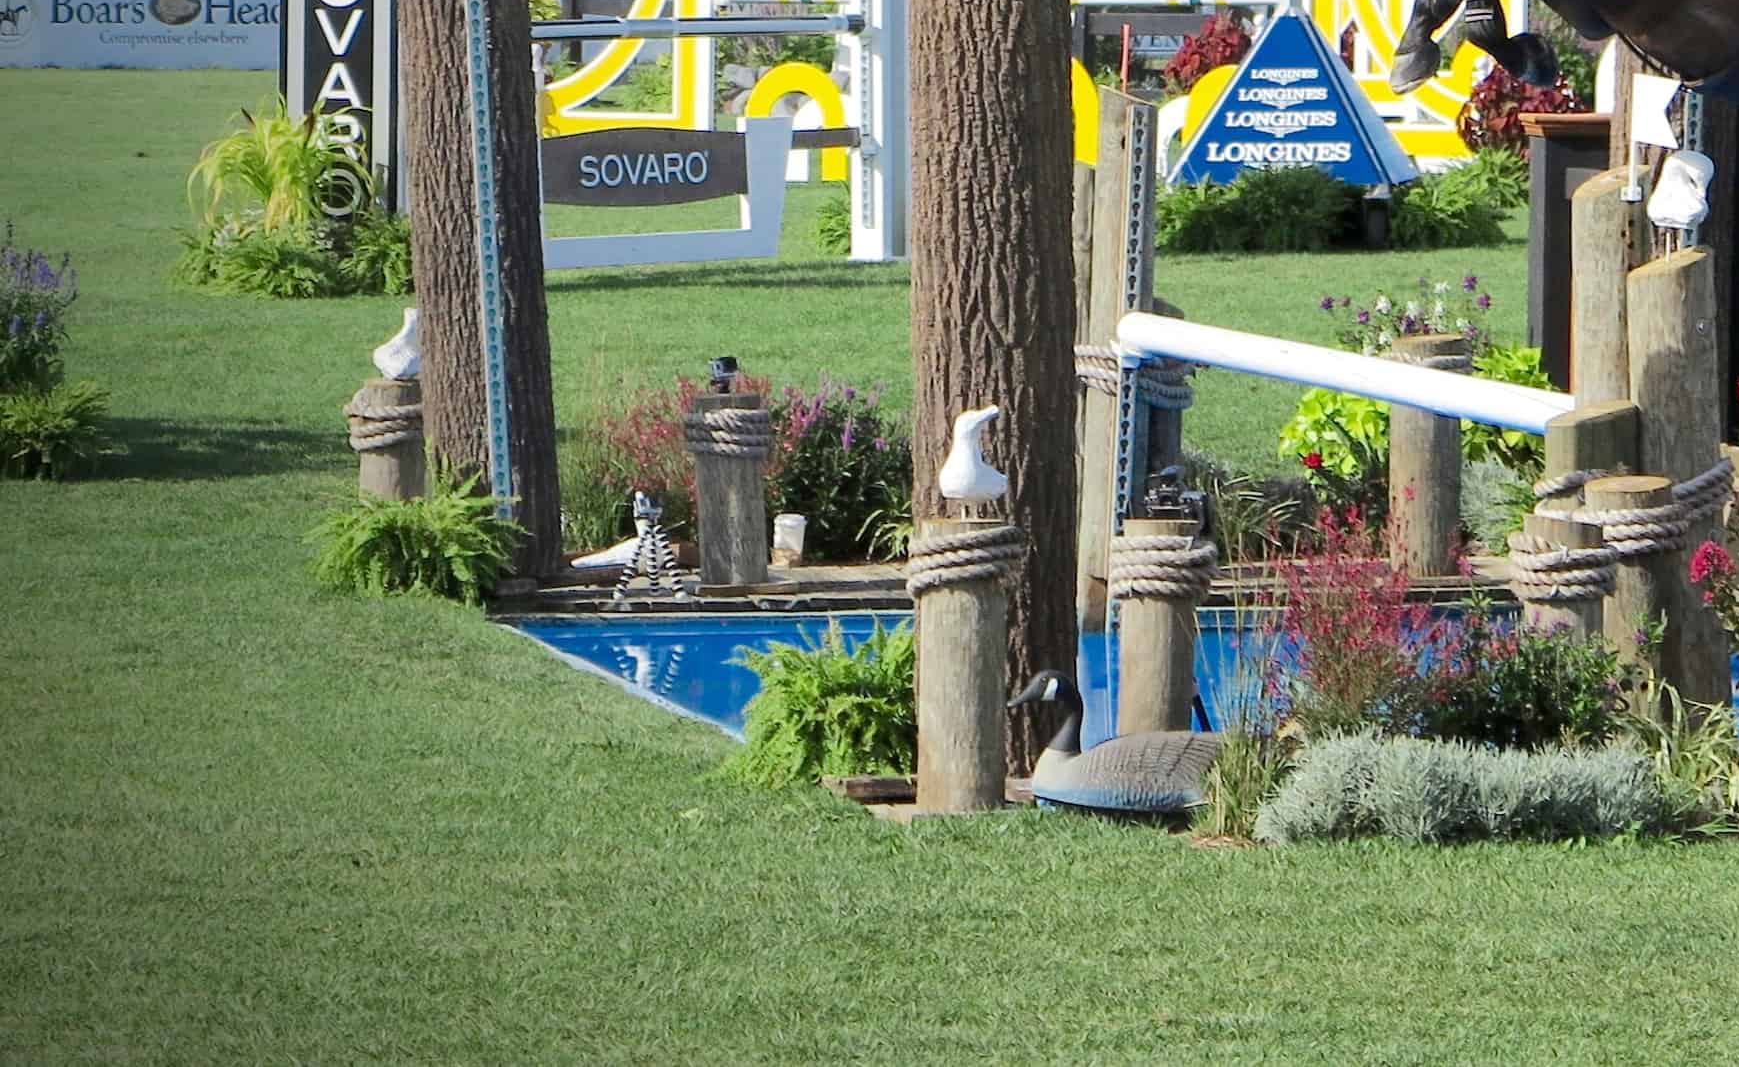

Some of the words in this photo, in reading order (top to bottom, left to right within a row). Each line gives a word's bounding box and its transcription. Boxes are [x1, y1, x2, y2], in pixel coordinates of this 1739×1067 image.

[99, 29, 185, 49] Compromise
[187, 29, 248, 45] elsewhere
[1251, 68, 1319, 80] LONGINES
[1238, 87, 1328, 102] LONGINES
[1225, 110, 1338, 128] LONGINES
[1206, 141, 1351, 162] LONGINES
